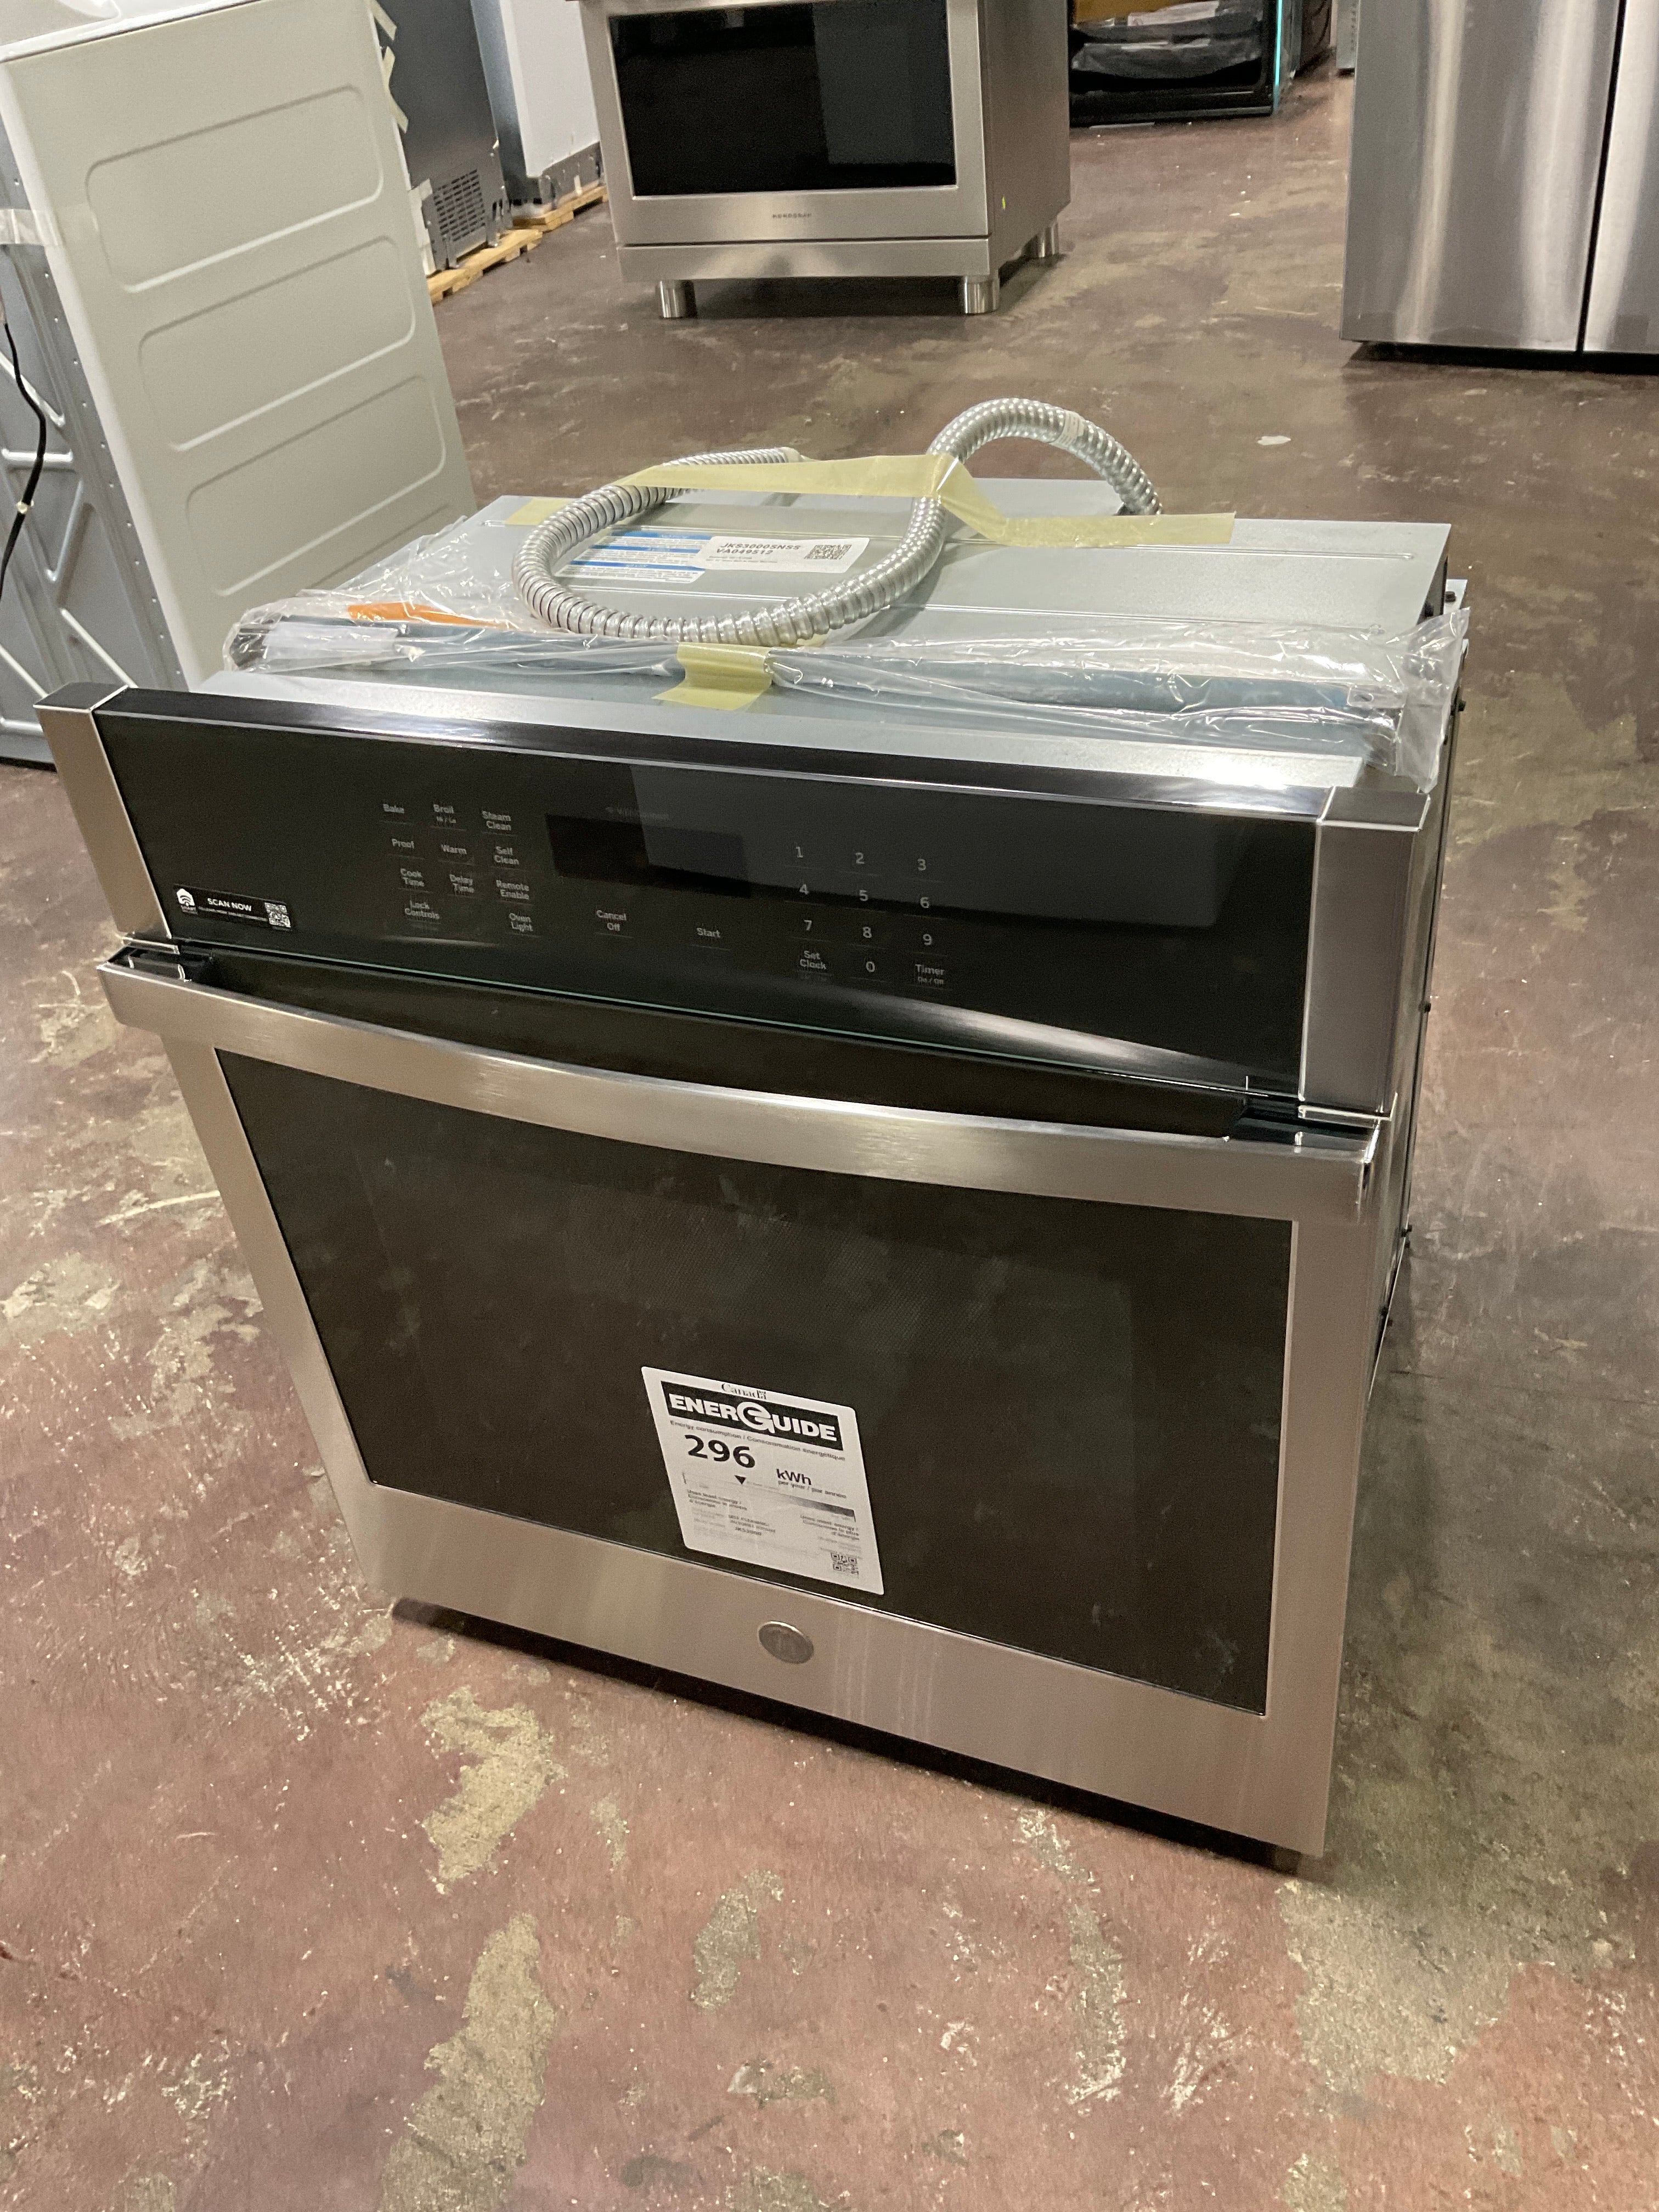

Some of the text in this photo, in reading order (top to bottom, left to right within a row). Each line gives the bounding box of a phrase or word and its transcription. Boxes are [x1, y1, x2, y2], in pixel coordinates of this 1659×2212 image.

[383, 804, 404, 814] Bake
[433, 804, 454, 814] Broil
[482, 811, 511, 822] Steam
[486, 821, 511, 831] Clean
[392, 838, 414, 849] Proof
[441, 844, 467, 854] Warm
[496, 847, 512, 856] Self
[795, 847, 803, 859] 1
[494, 855, 519, 865] Clean
[855, 852, 865, 864] 2
[917, 859, 926, 871] 3
[400, 868, 422, 878] Cook
[403, 877, 425, 887] Time
[449, 874, 473, 885] Delay
[452, 883, 474, 894] Time
[496, 880, 529, 891] Remote
[799, 884, 809, 895] 4
[500, 889, 529, 900] Enable
[859, 890, 868, 901] 5
[207, 898, 252, 912] SCAN NOW
[409, 900, 430, 910] Lock
[920, 897, 929, 909] 6
[404, 908, 439, 919] Controls
[509, 913, 531, 922] Oven
[596, 910, 627, 921] Cancel
[511, 922, 533, 932] Light
[607, 922, 620, 931] Off
[804, 920, 812, 930] 7
[696, 927, 721, 938] Start
[862, 927, 872, 938] 8
[923, 934, 932, 945] 9
[804, 950, 821, 960] Set
[800, 959, 827, 969] Clock
[866, 961, 875, 972] 0
[915, 964, 945, 975] Timer
[721, 1383, 766, 1400] Canada
[669, 1393, 837, 1441] ENERGUIDE
[670, 1420, 693, 1431] Energy
[696, 1426, 742, 1439] consumption
[685, 1434, 755, 1469] 296
[776, 1469, 812, 1485] kWh
